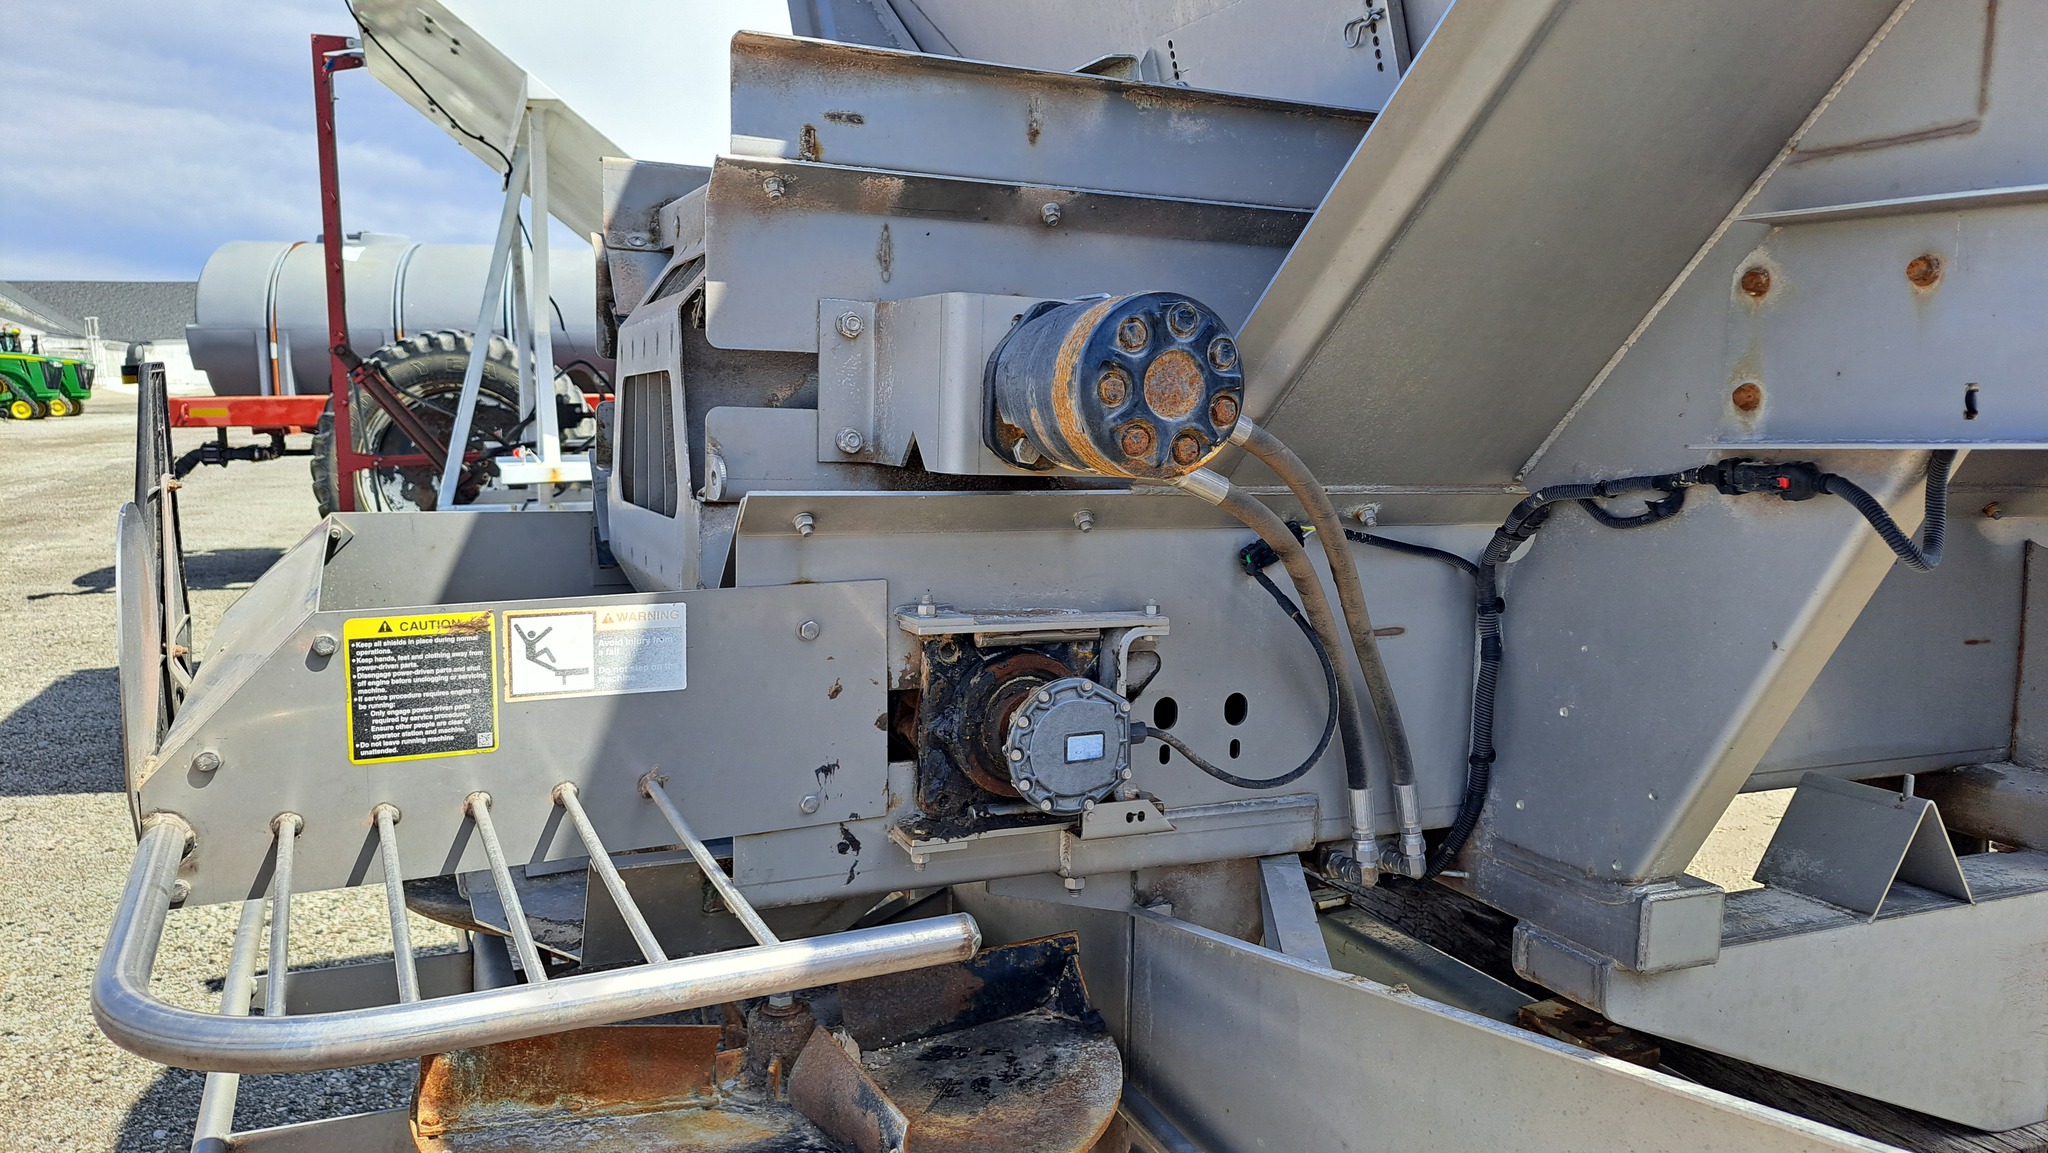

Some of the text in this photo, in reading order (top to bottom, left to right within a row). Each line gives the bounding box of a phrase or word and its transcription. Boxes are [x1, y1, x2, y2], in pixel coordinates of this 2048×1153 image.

[616, 610, 679, 621] WARNING
[355, 641, 373, 649] Keep
[373, 640, 382, 648] all
[382, 638, 407, 647] shields
[415, 637, 433, 646] place
[433, 636, 455, 644] during
[456, 634, 479, 642] normal
[355, 648, 393, 657] operations.
[356, 649, 484, 665] Keep hands, feet and clothing away from
[356, 661, 419, 673] power-driven parts.
[356, 664, 481, 680] Disengage power-driven parts and shut
[357, 680, 367, 688] off
[367, 679, 390, 688] engine
[390, 678, 412, 686] before
[412, 675, 449, 684] unclogging
[457, 672, 487, 681] servicing
[357, 687, 388, 696] machine.
[357, 695, 363, 703] If
[363, 694, 389, 703] service
[389, 692, 422, 702] procedure
[422, 690, 450, 699] requires
[450, 688, 472, 697] engine
[358, 701, 396, 711] be running:
[370, 703, 471, 718] Only engage power-driven parts
[371, 711, 469, 726] required by service procedure.
[370, 725, 395, 733] Ensure
[394, 723, 413, 731] other
[413, 721, 436, 730] people
[372, 726, 468, 741] operator station and machine.
[360, 734, 455, 749] Do not leave running machine
[360, 746, 399, 757] unattended.
